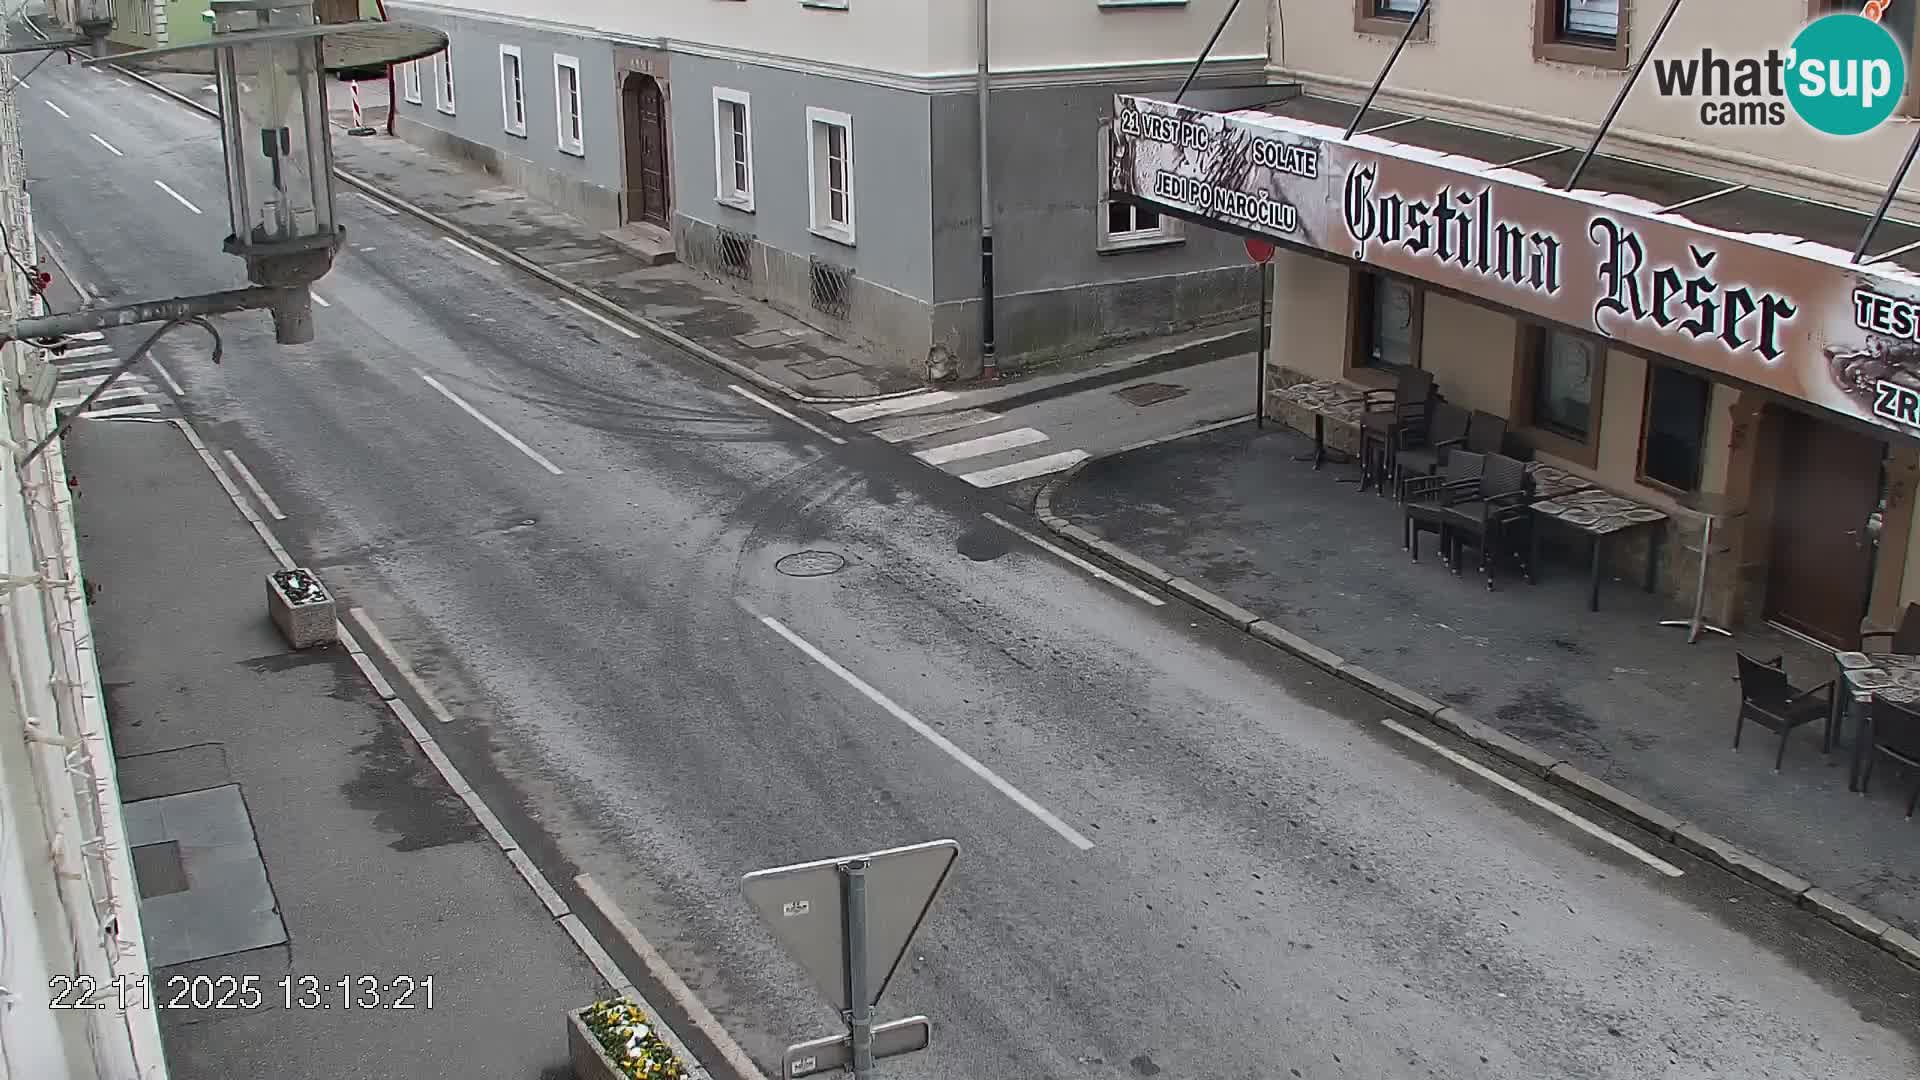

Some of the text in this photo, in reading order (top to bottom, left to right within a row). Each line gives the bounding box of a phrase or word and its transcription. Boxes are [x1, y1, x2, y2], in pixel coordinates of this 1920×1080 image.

[1122, 110, 1209, 150] 21 VRST PIC
[1253, 139, 1317, 178] SOLATE
[1155, 171, 1296, 231] JEDI PO NAROČILU
[1345, 161, 1797, 361] Gostilna Rešer
[1874, 380, 1920, 428] ZR
